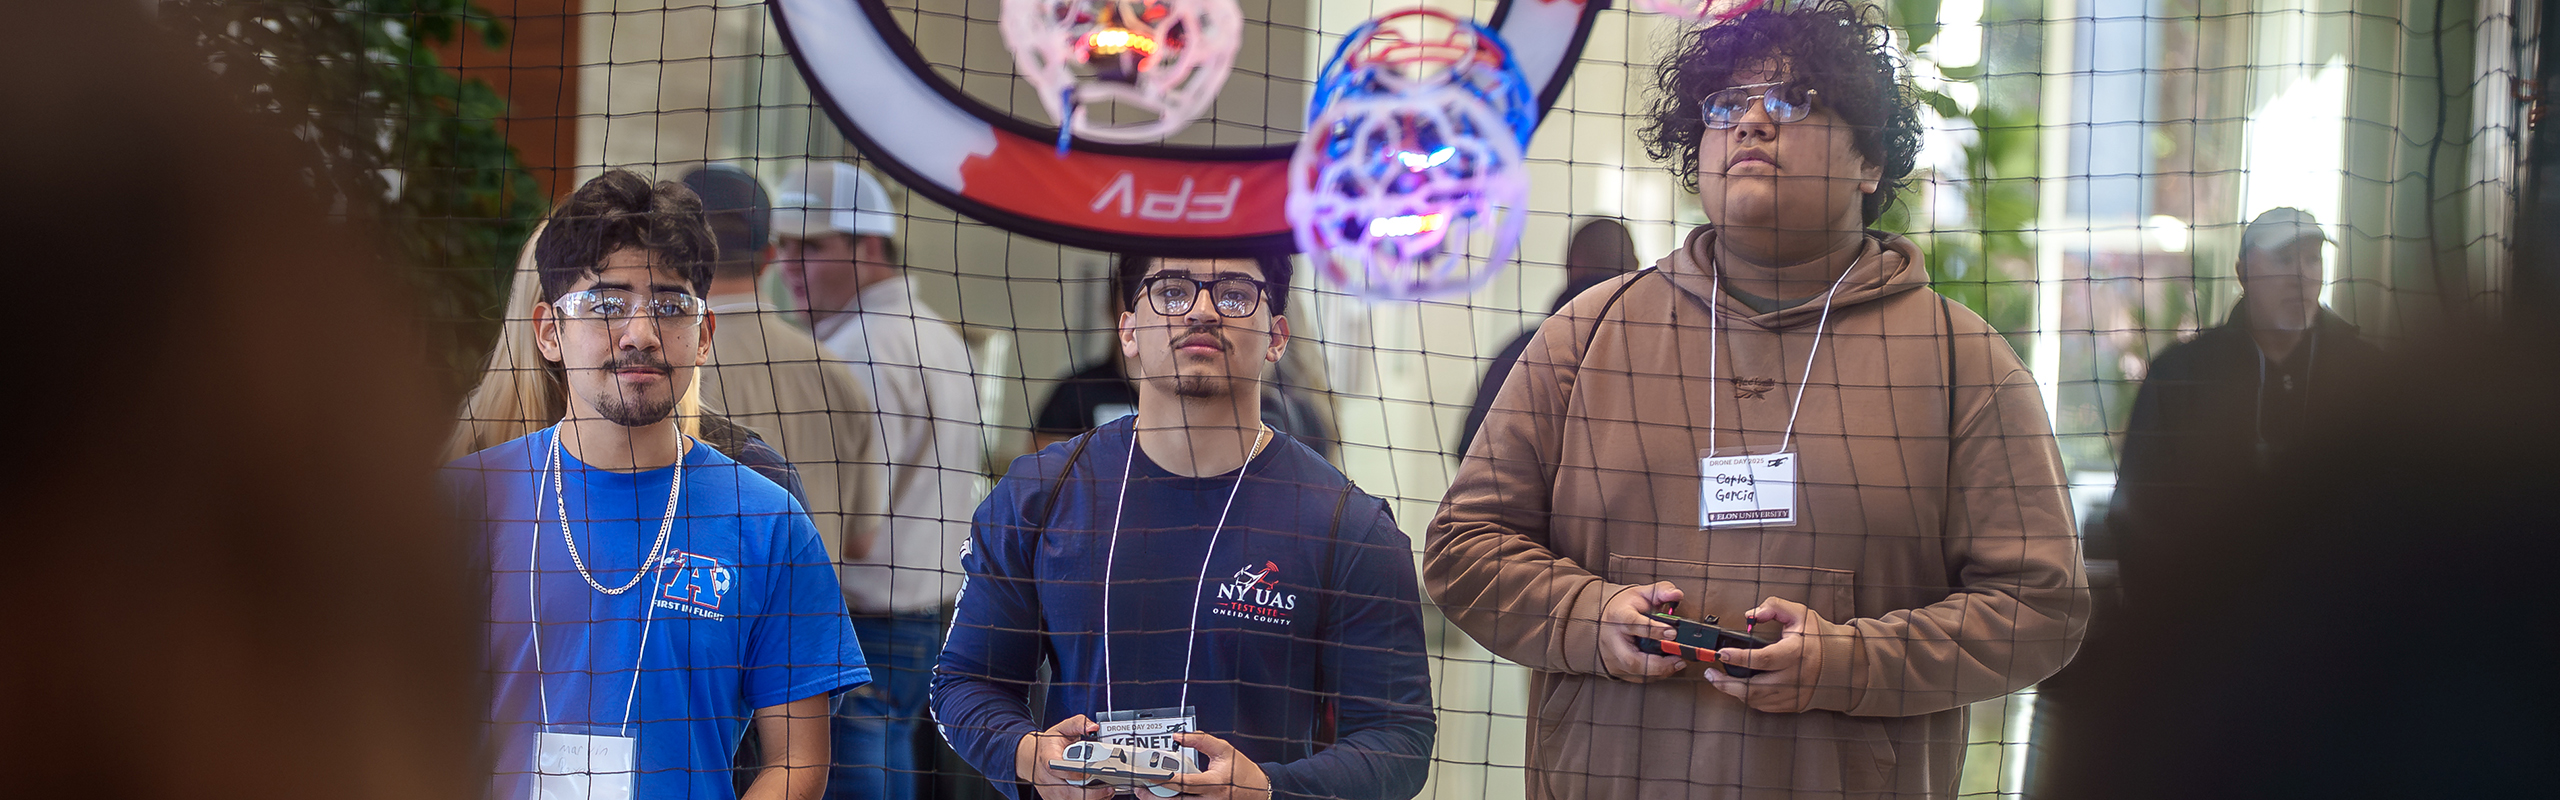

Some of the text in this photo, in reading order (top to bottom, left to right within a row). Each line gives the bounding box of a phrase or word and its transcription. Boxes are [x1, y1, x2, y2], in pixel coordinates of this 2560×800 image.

[1090, 171, 1243, 221] FPV
[1734, 376, 1775, 387] Reeb
[1709, 459, 1732, 467] DRONE
[1716, 473, 1755, 486] Carlos
[1715, 489, 1755, 502] Garcia
[1716, 510, 1788, 521] ELON UNIVERSITY
[663, 551, 722, 611] A
[1216, 583, 1297, 610] NY UAS
[693, 607, 725, 622] FLIGHT
[1212, 607, 1291, 626] ONEIDA COUNTY
[1231, 602, 1279, 617] TEST SITE
[1106, 724, 1131, 732] DRONE
